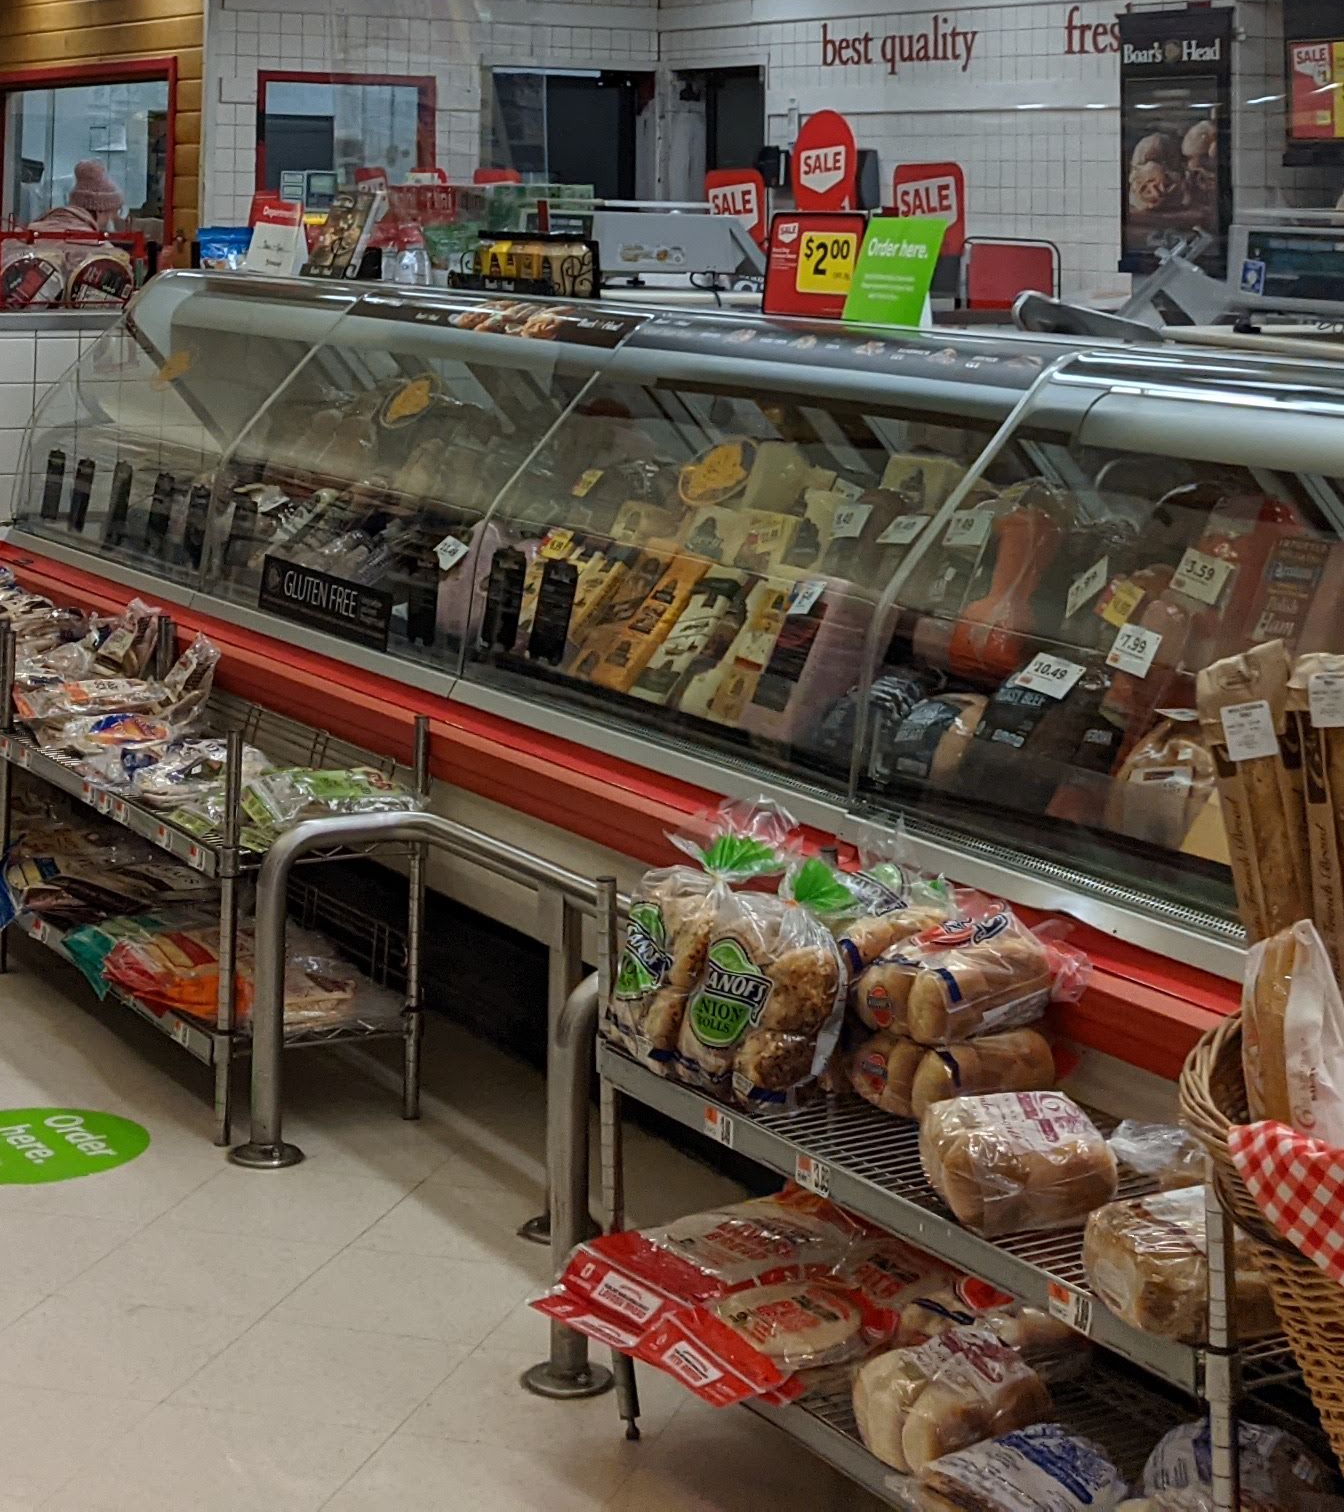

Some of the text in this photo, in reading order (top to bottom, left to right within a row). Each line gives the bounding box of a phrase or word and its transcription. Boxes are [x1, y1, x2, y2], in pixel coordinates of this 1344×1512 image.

[822, 4, 1126, 75] best quality fres
[1123, 39, 1220, 64] Boar's Head
[1296, 48, 1327, 64] SALE
[803, 152, 842, 176] SALE
[712, 190, 753, 216] SALE
[901, 184, 952, 216] SALE
[780, 225, 797, 236] SALE
[867, 238, 928, 259] Order here.
[284, 570, 359, 619] GLUTEN FREE
[44, 1114, 118, 1157] Order
